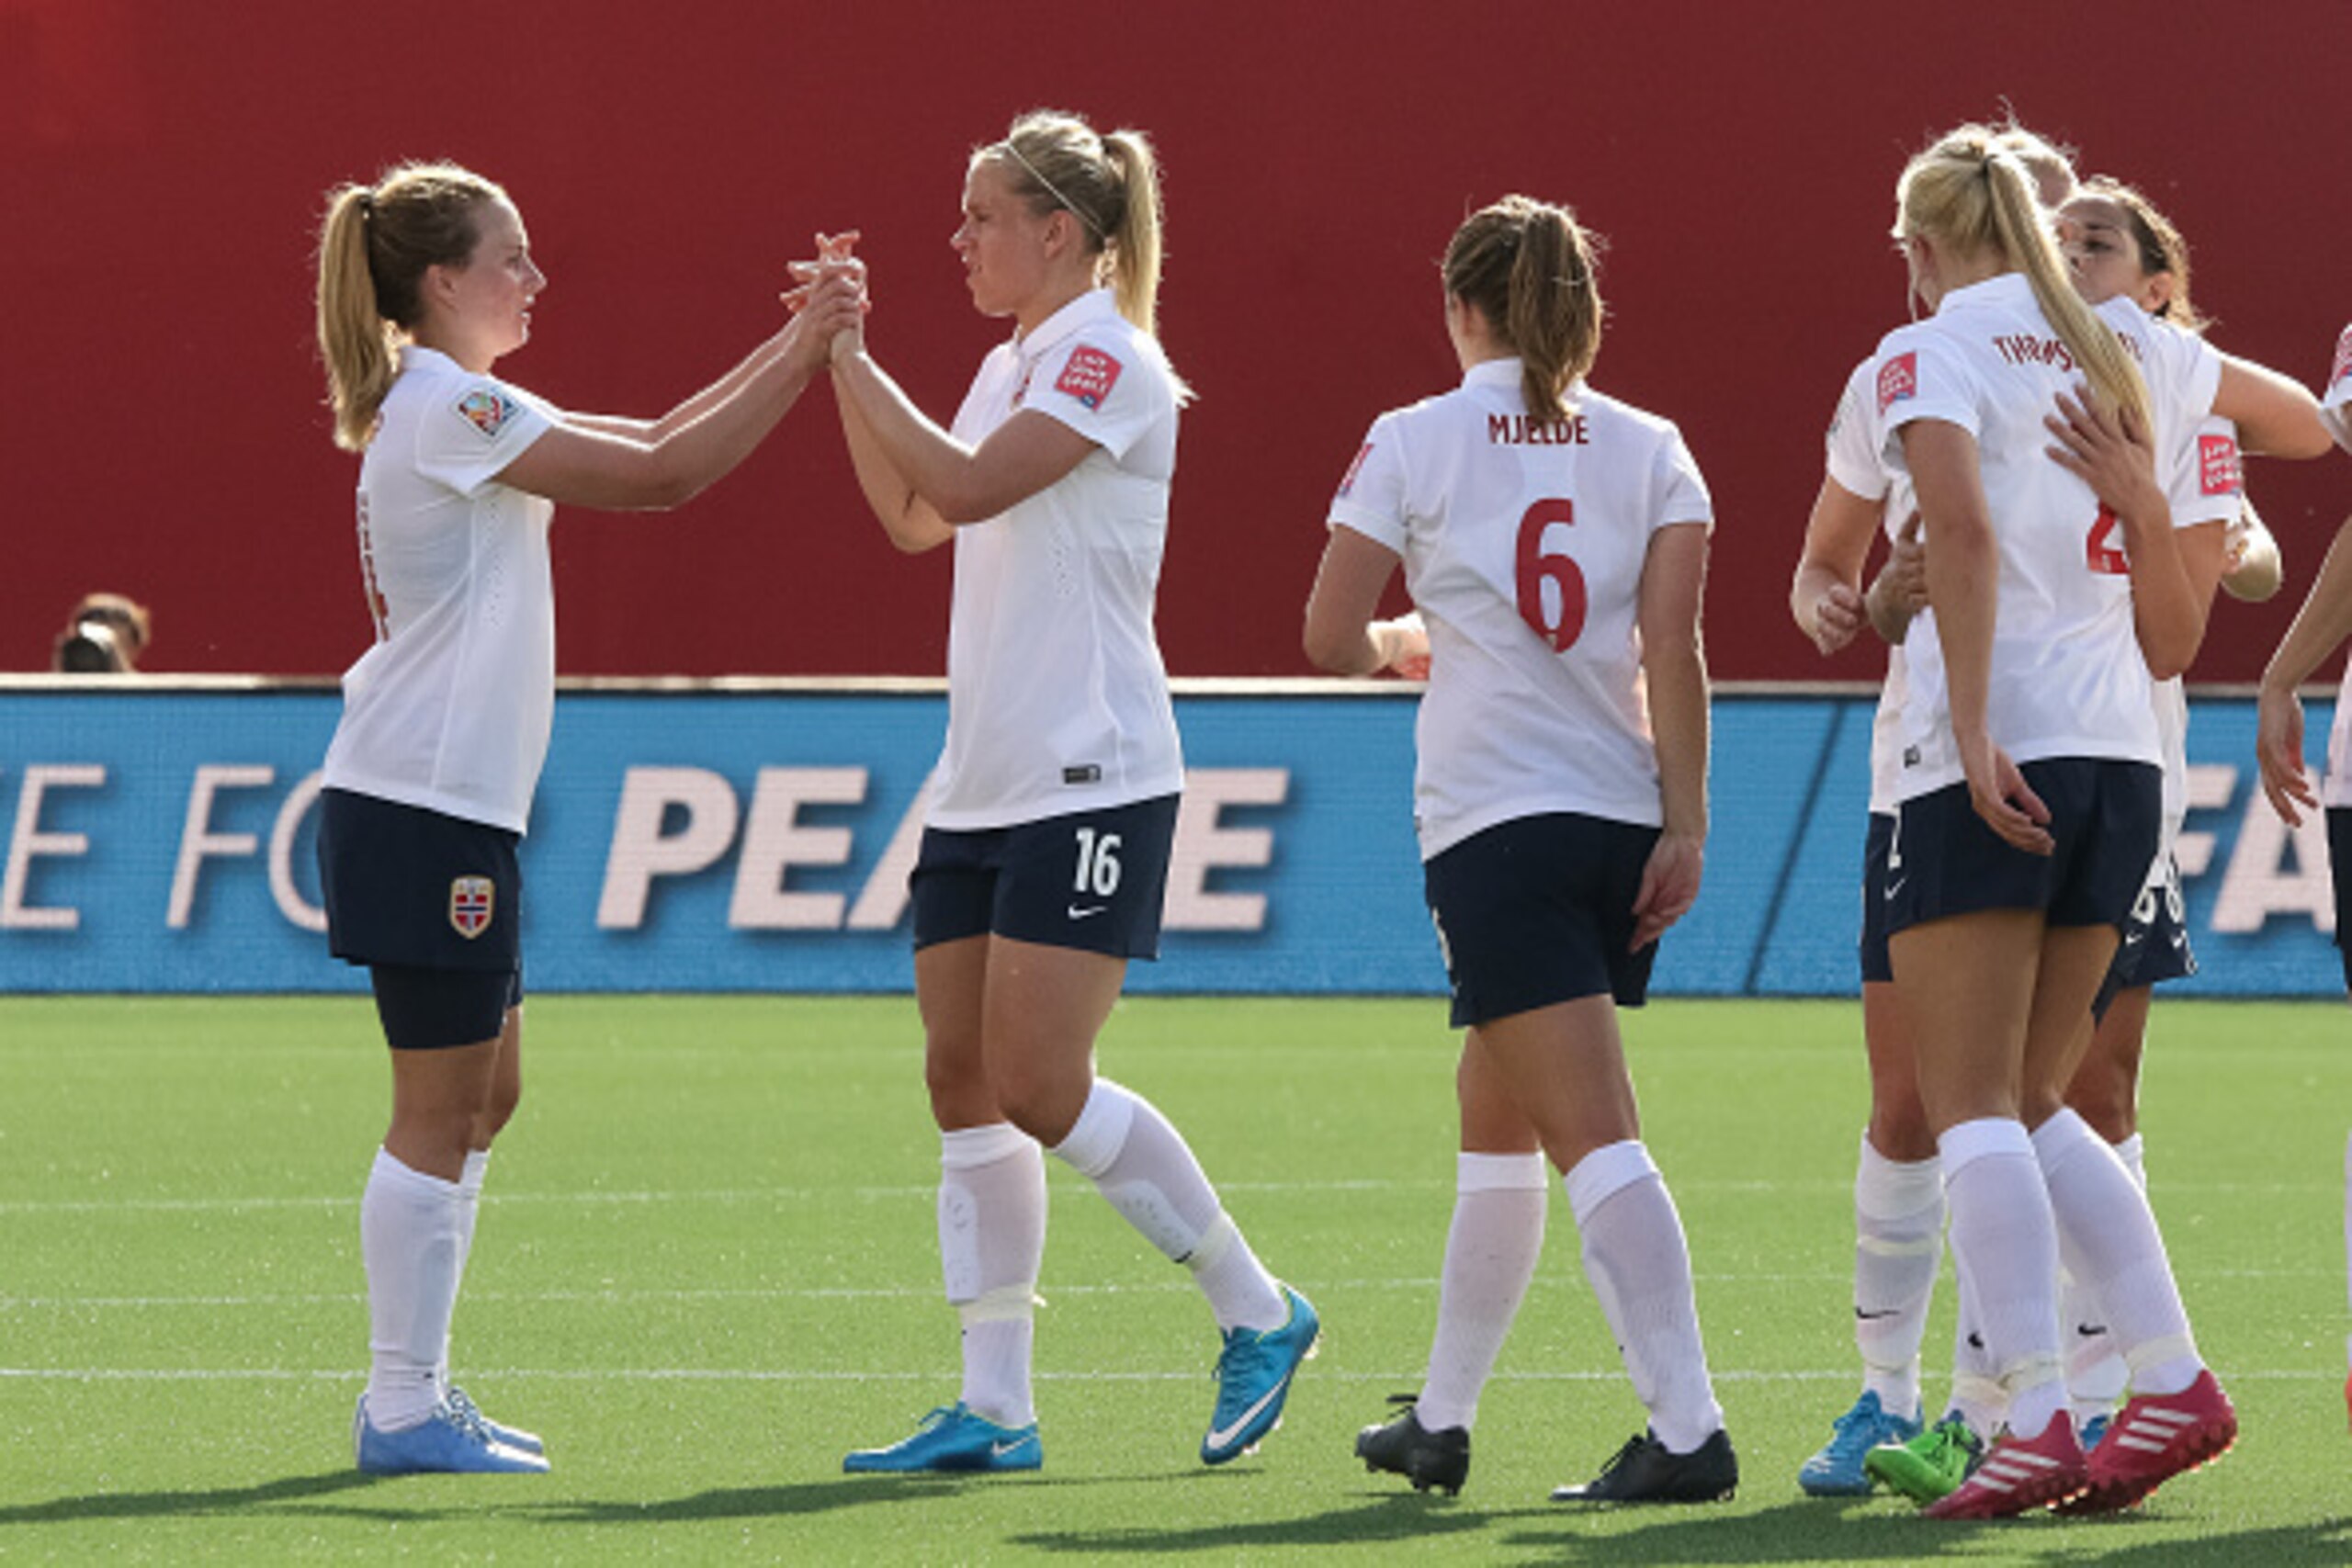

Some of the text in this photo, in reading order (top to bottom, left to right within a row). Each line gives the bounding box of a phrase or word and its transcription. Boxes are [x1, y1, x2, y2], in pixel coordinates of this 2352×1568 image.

[1487, 413, 1589, 446] MJELDE
[1514, 497, 1588, 654] 6
[1073, 827, 1123, 897] 16
